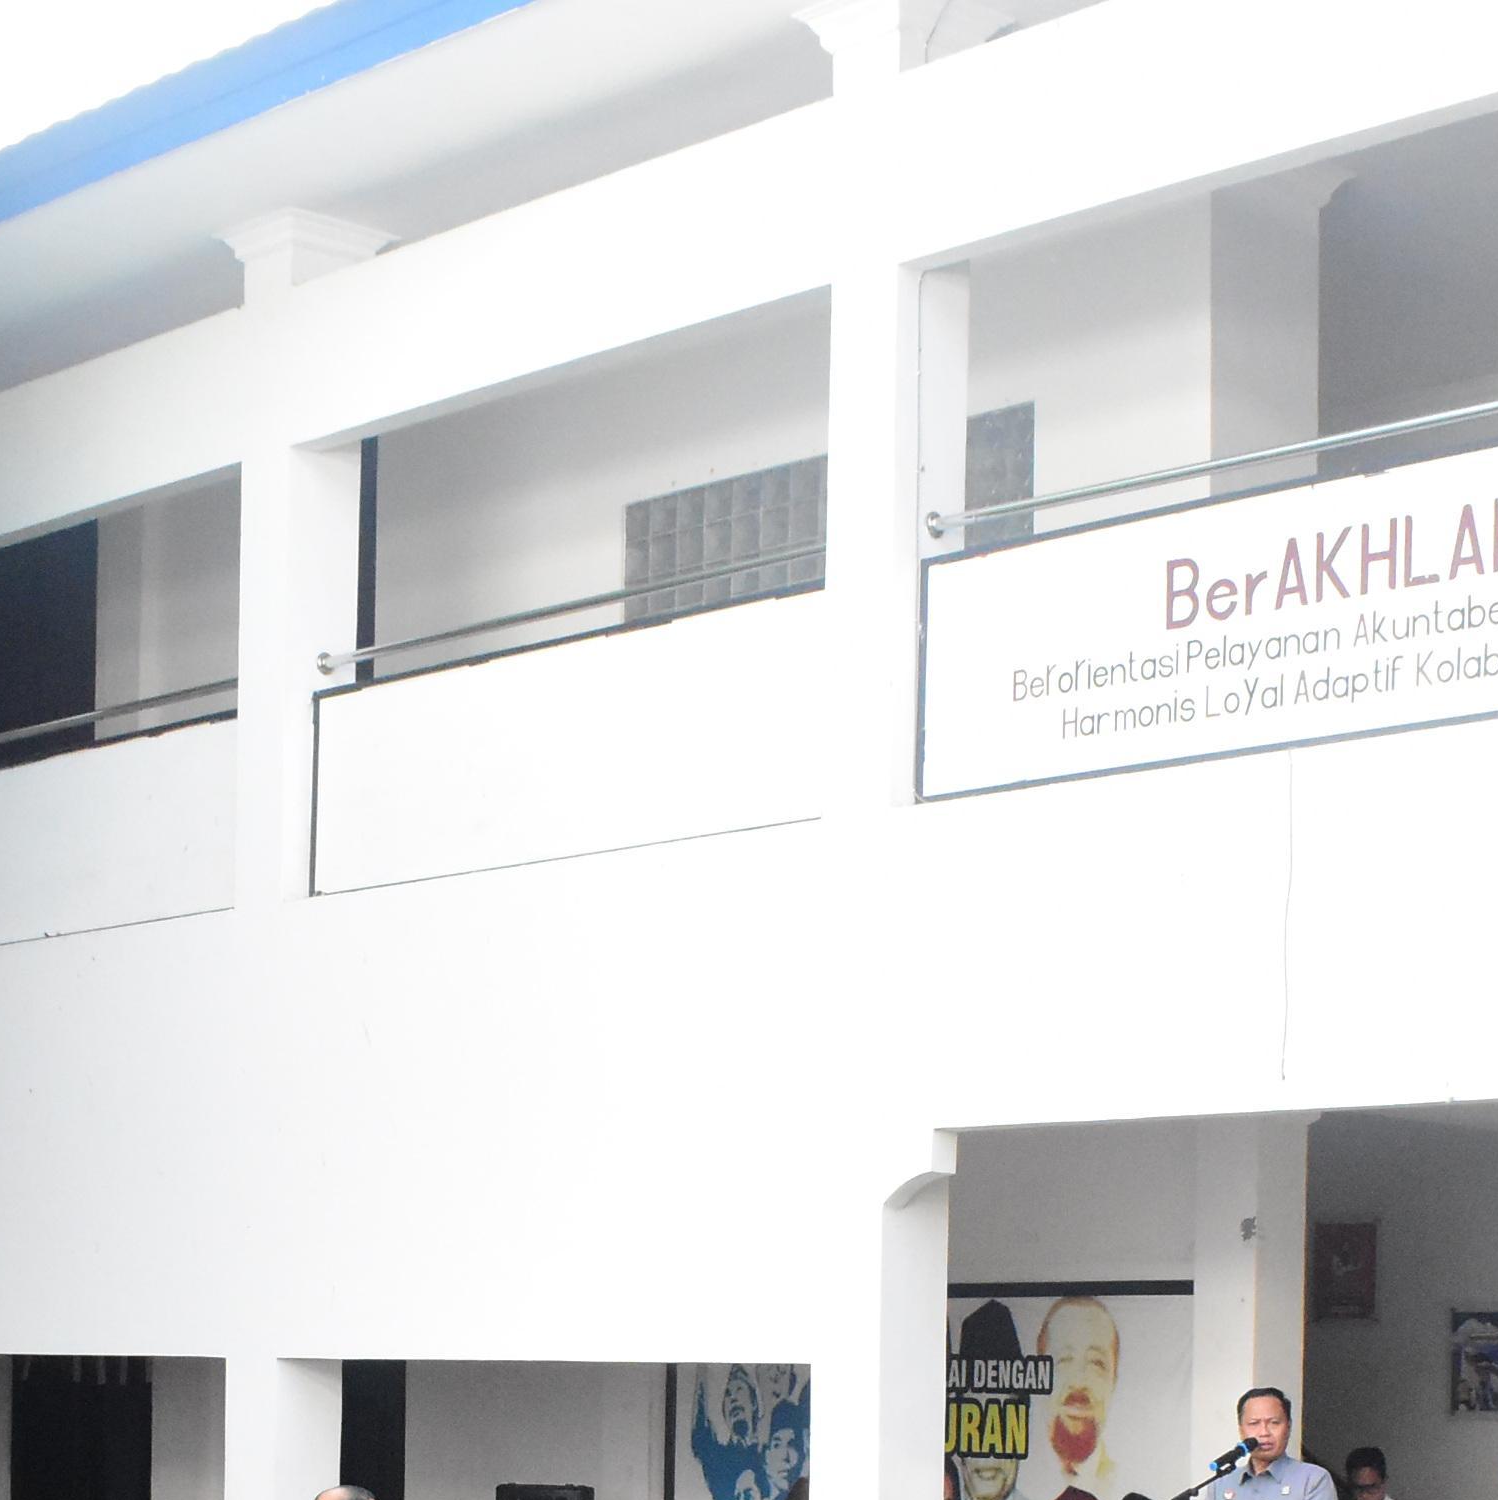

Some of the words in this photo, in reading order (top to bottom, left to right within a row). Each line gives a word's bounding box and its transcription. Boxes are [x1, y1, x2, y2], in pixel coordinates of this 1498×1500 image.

[1186, 626, 1341, 673] Pelayanan
[1061, 689, 1196, 740] Harmonis
[1293, 655, 1404, 704] Adaptif
[973, 1359, 1051, 1390] DENGAN
